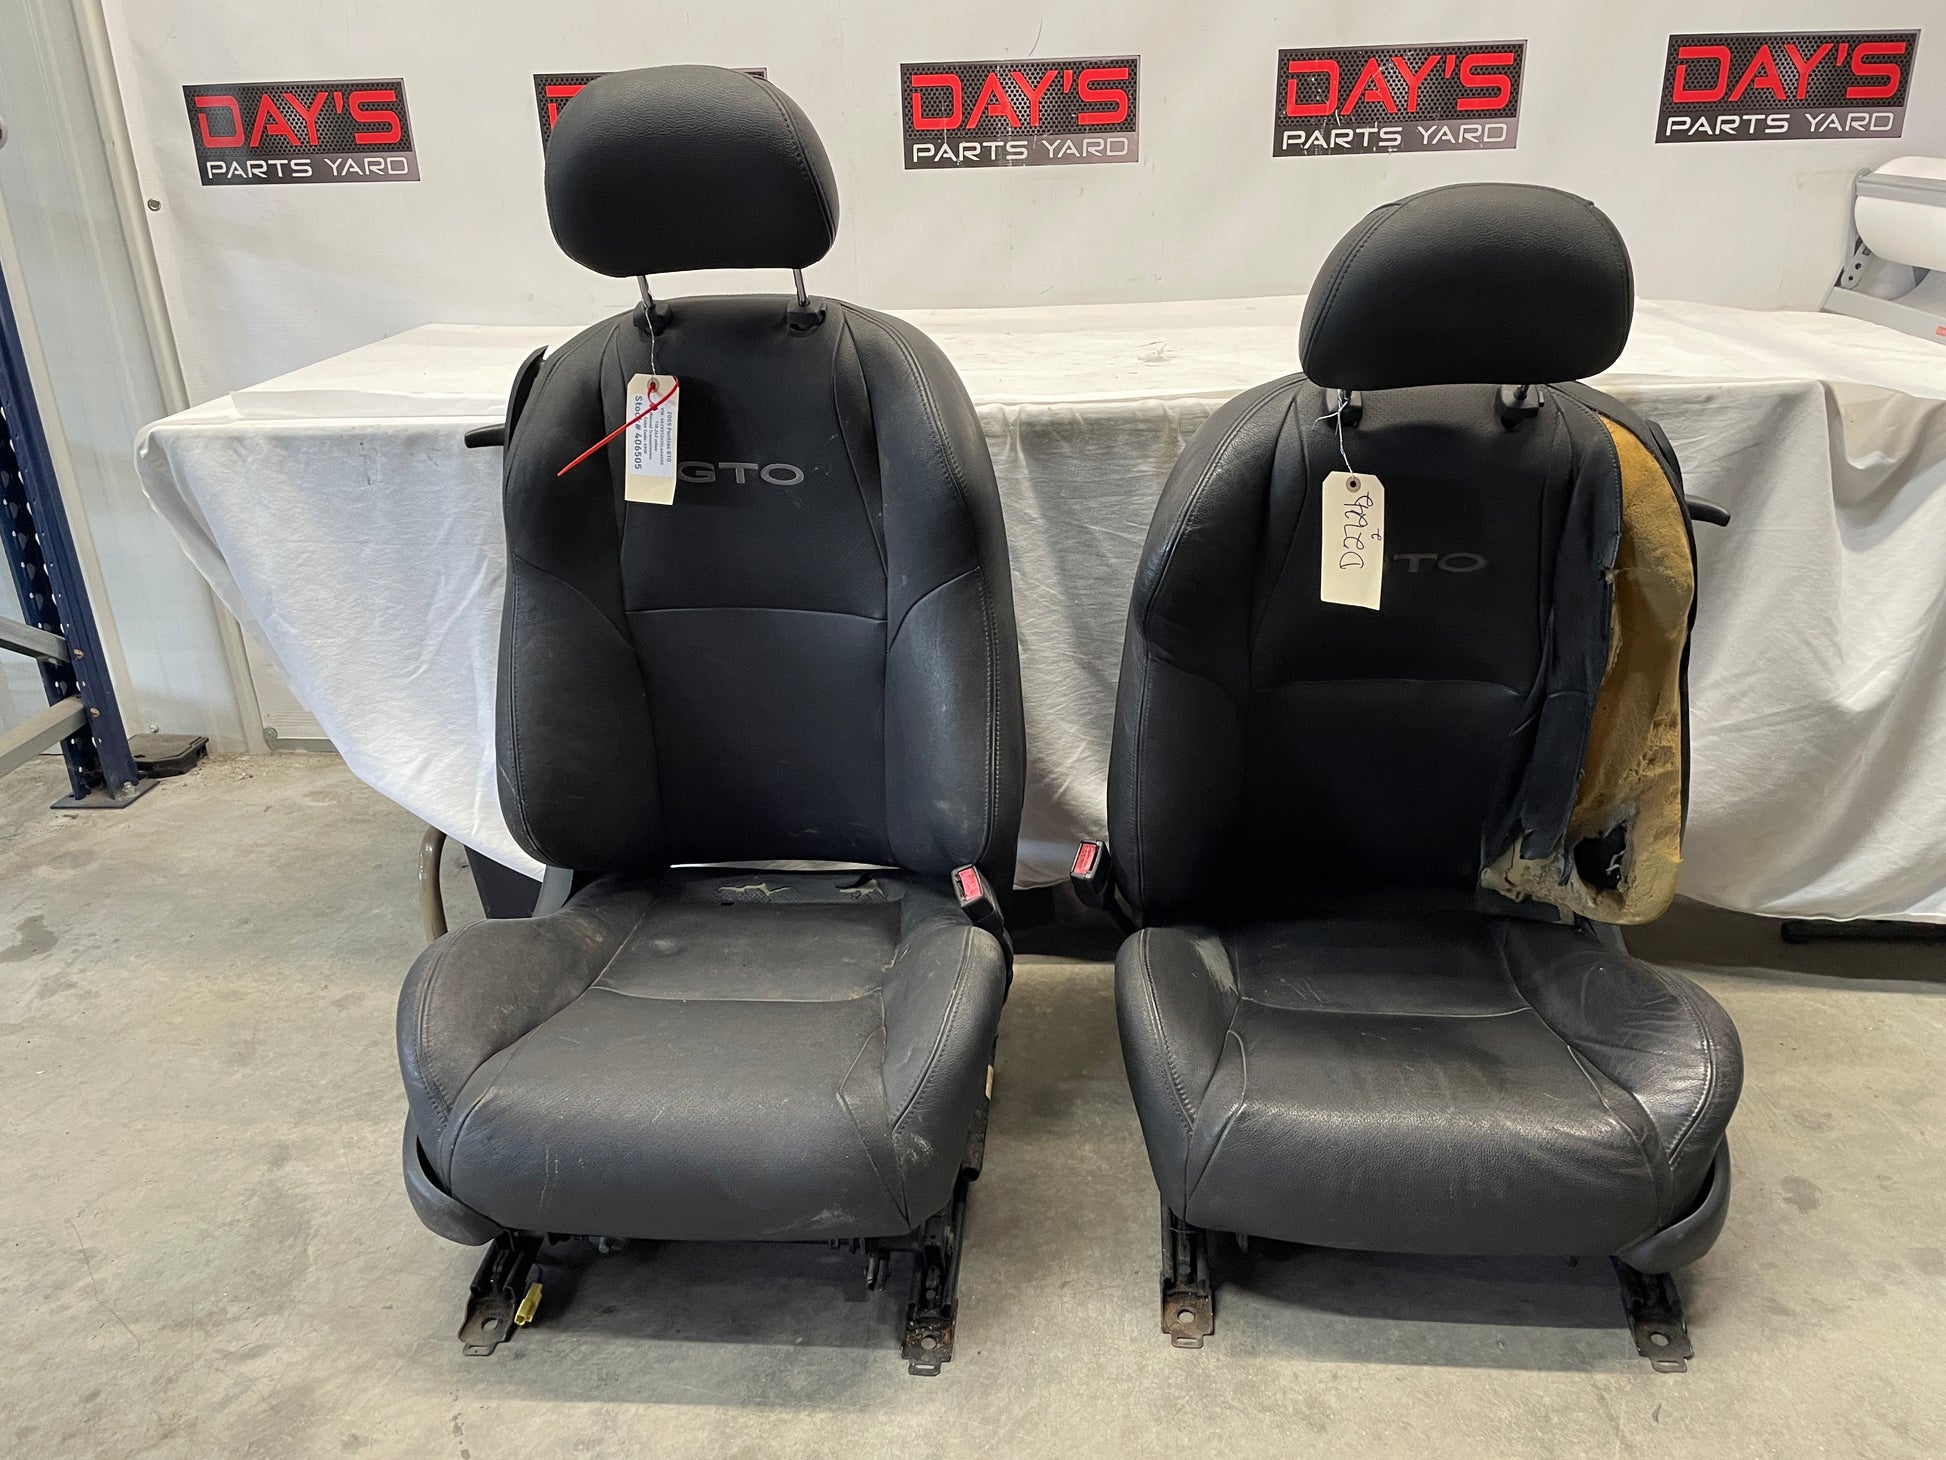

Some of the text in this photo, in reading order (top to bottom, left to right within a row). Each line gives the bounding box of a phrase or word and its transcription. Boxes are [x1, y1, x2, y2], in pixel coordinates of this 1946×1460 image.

[1286, 52, 1514, 117] DAY'S
[1672, 41, 1906, 103] DAY'S
[911, 67, 1129, 131] DAY'S
[195, 90, 401, 148] DAY'S
[1665, 112, 1894, 136] PARTS YARD
[913, 137, 1128, 162] PARTS YARD
[1282, 123, 1507, 150] PARTS YARD
[207, 156, 409, 179] PARTS YARD
[634, 395, 643, 423] Stoc
[634, 432, 643, 470] 406505
[678, 460, 805, 486] GTO
[1384, 552, 1488, 574] TO
